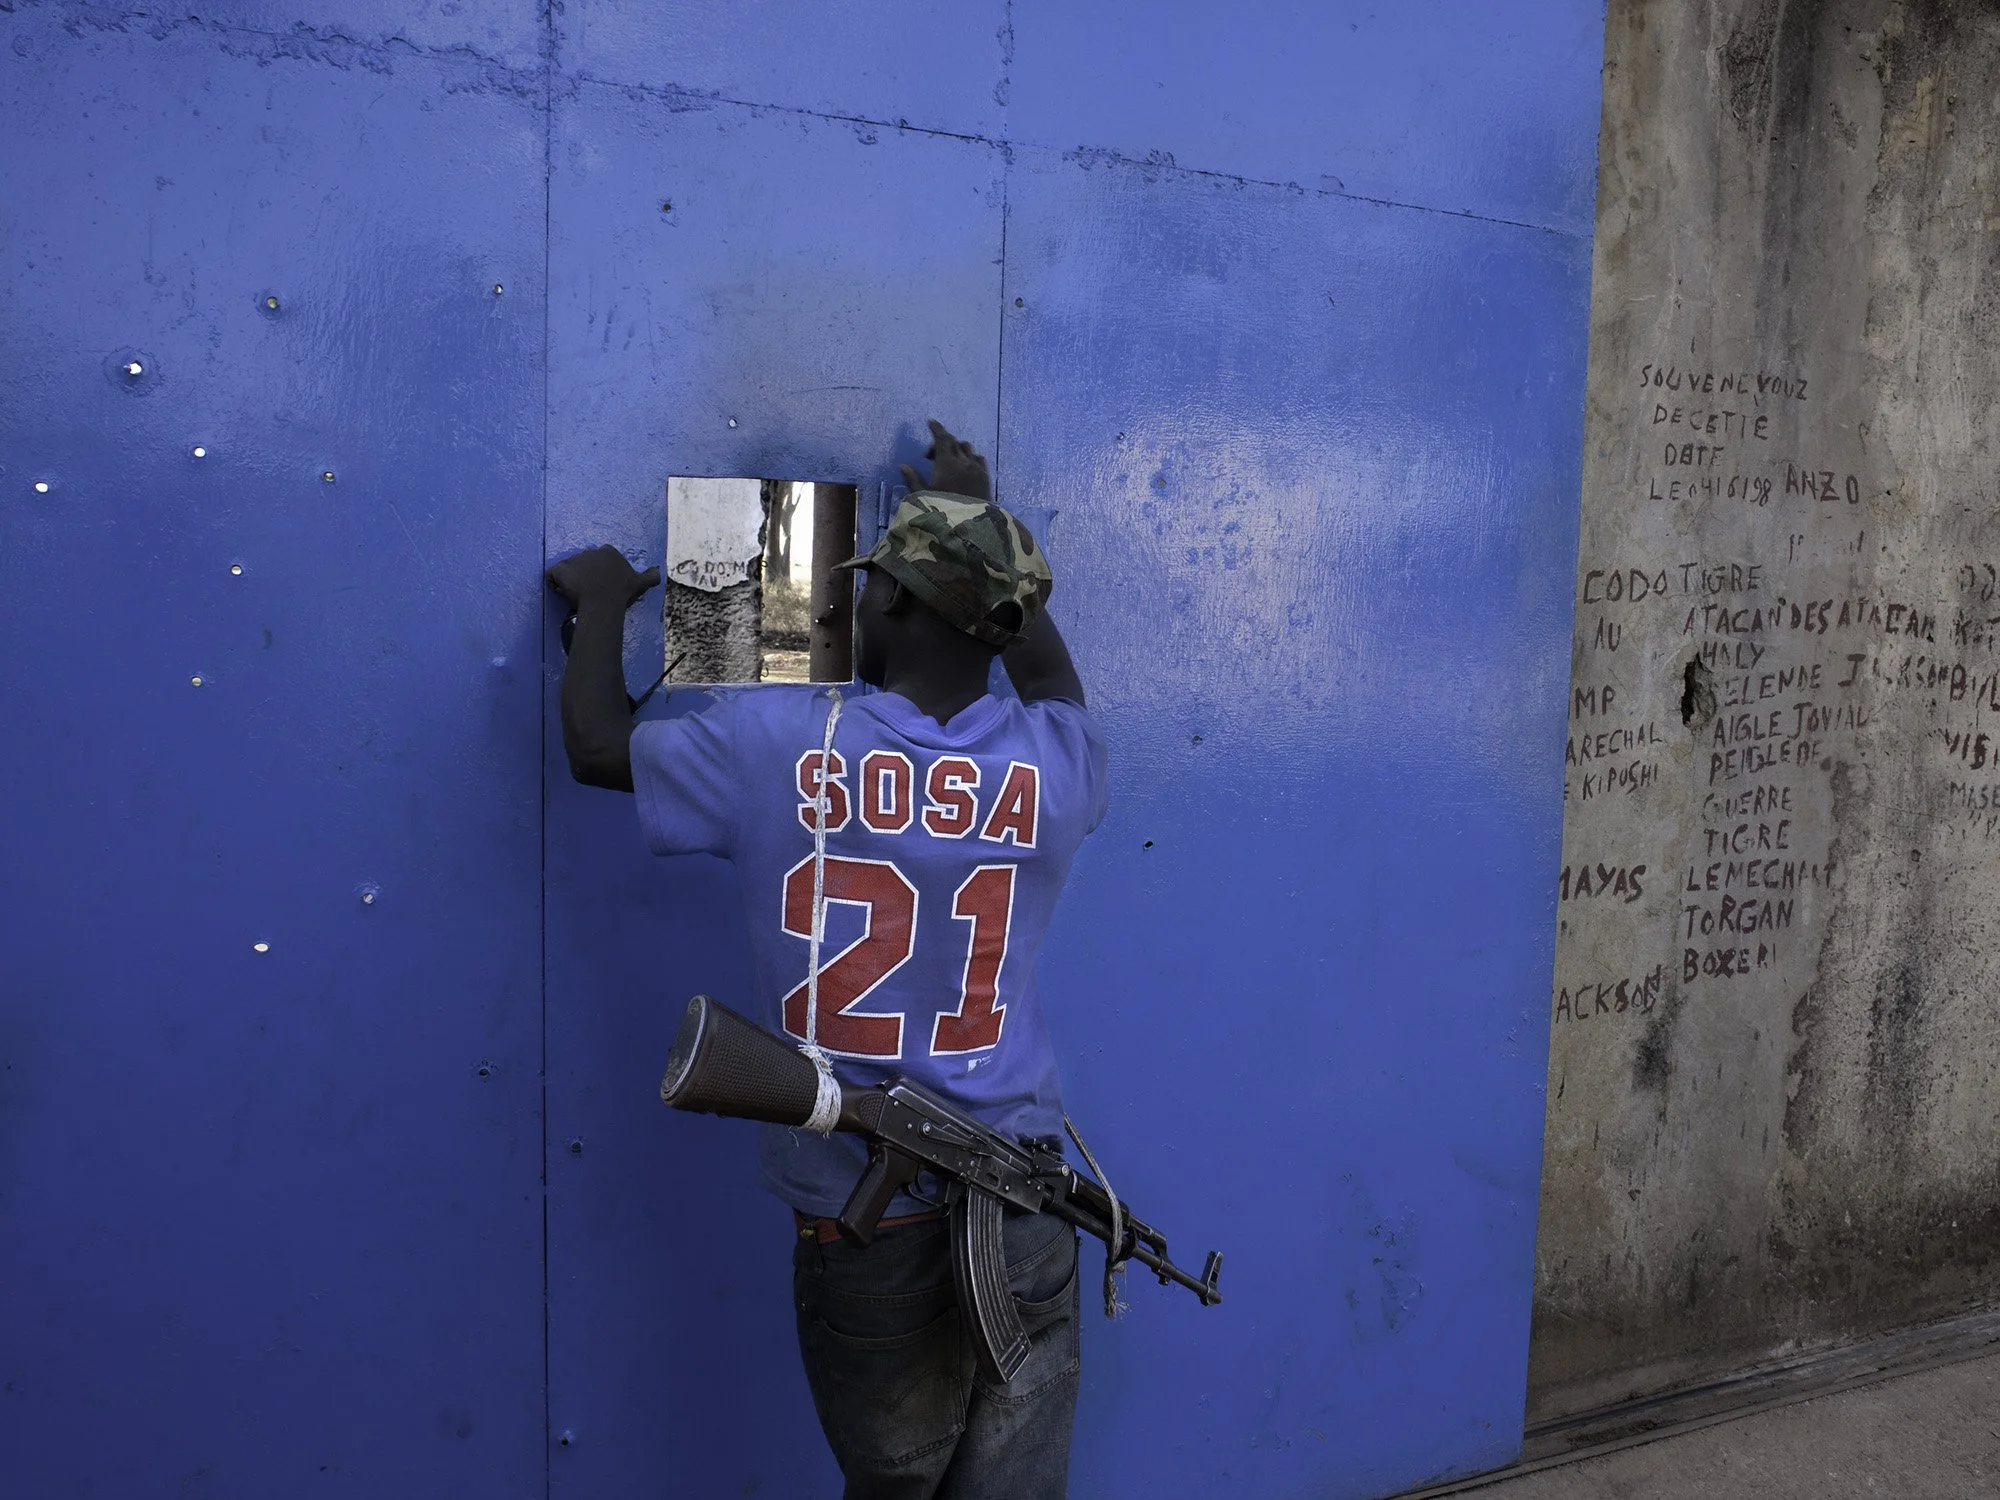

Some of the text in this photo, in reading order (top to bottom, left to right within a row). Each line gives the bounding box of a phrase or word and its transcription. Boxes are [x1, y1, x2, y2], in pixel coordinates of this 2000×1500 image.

[1583, 562, 1763, 605] CODO TIGRE
[1574, 684, 1616, 719] MP
[1713, 709, 1782, 748] AIGLE
[795, 748, 1041, 849] SOSA
[1703, 819, 1792, 857] TIGRE
[1684, 893, 1794, 940] TORGAN
[781, 850, 1019, 1060] 21
